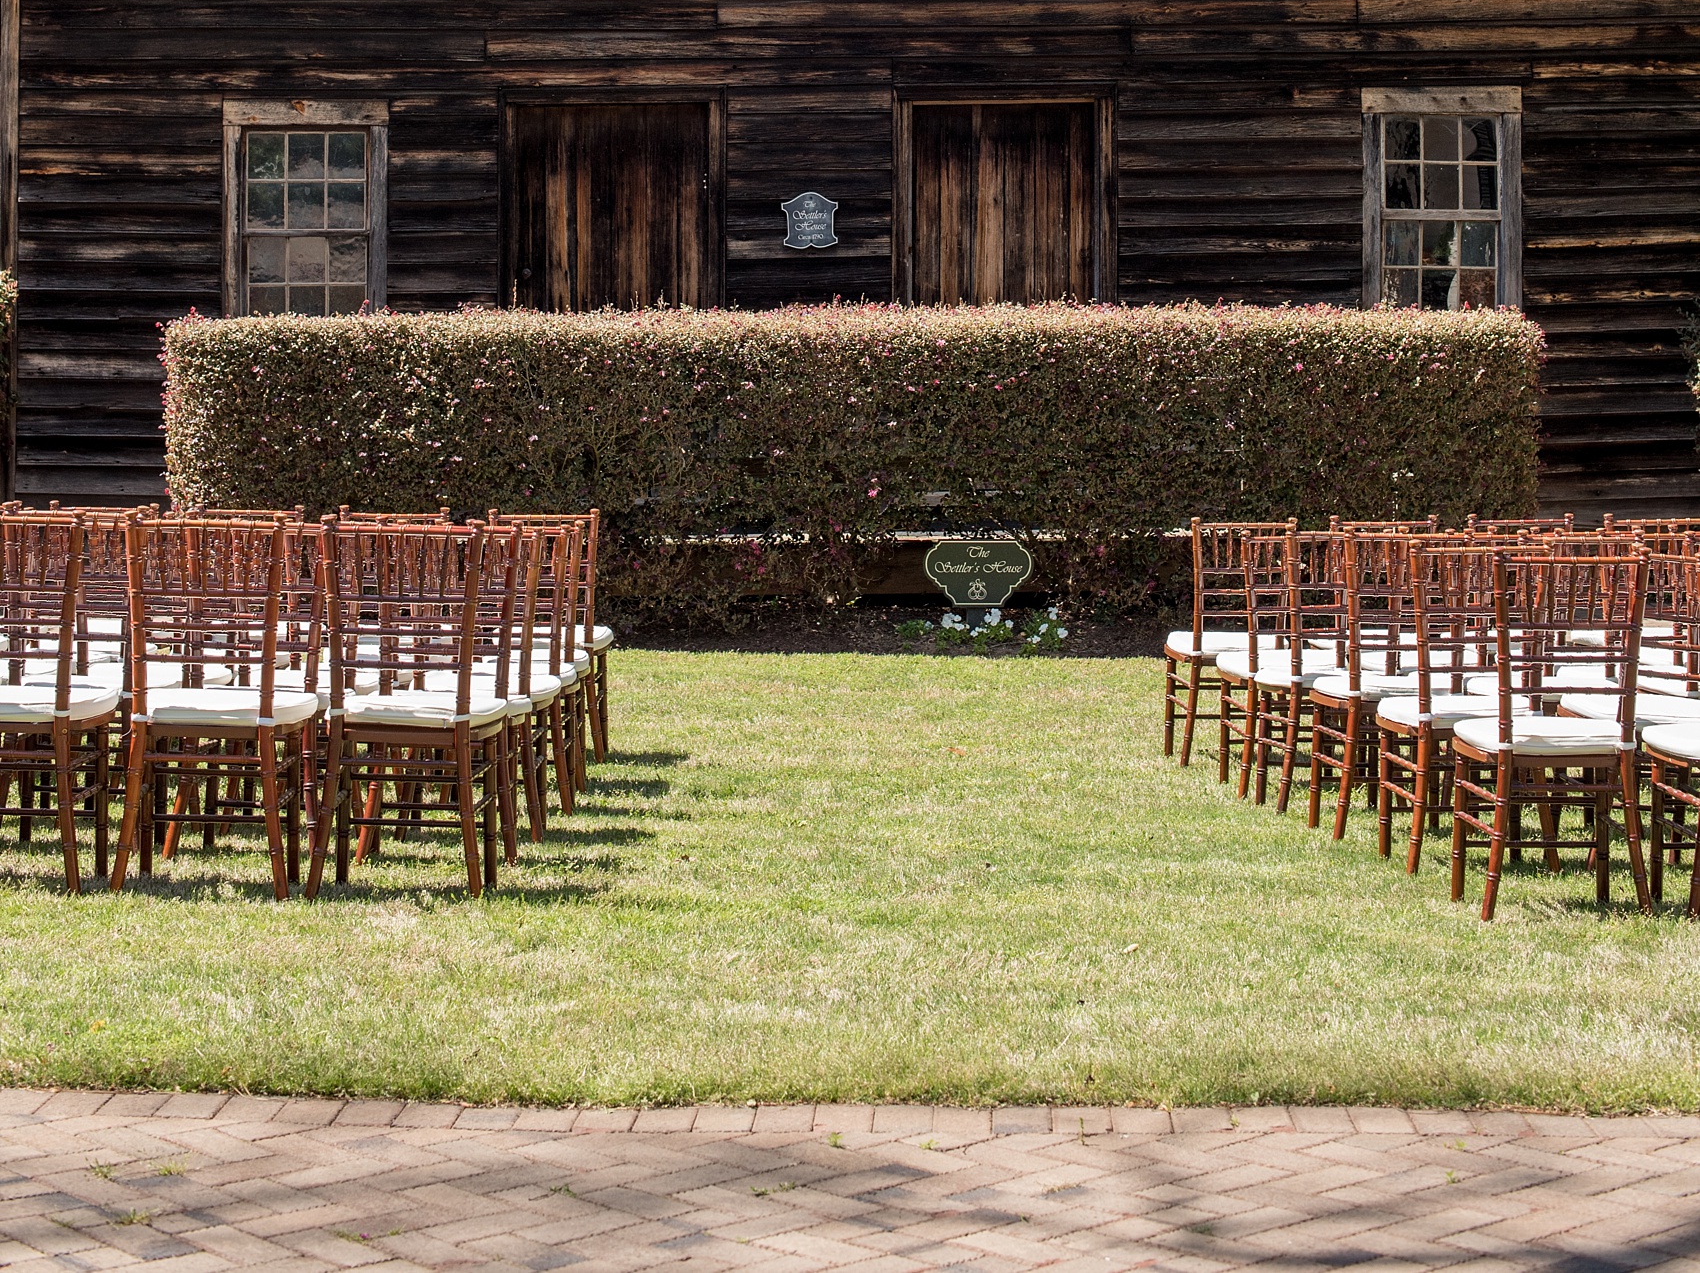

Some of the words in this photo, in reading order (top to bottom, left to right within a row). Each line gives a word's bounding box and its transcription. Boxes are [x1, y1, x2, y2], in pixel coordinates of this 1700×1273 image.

[803, 200, 817, 208] The
[792, 209, 827, 220] Settler's
[795, 220, 827, 231] House
[966, 546, 990, 558] The
[934, 561, 980, 573] Settler's
[982, 560, 1023, 573] House
